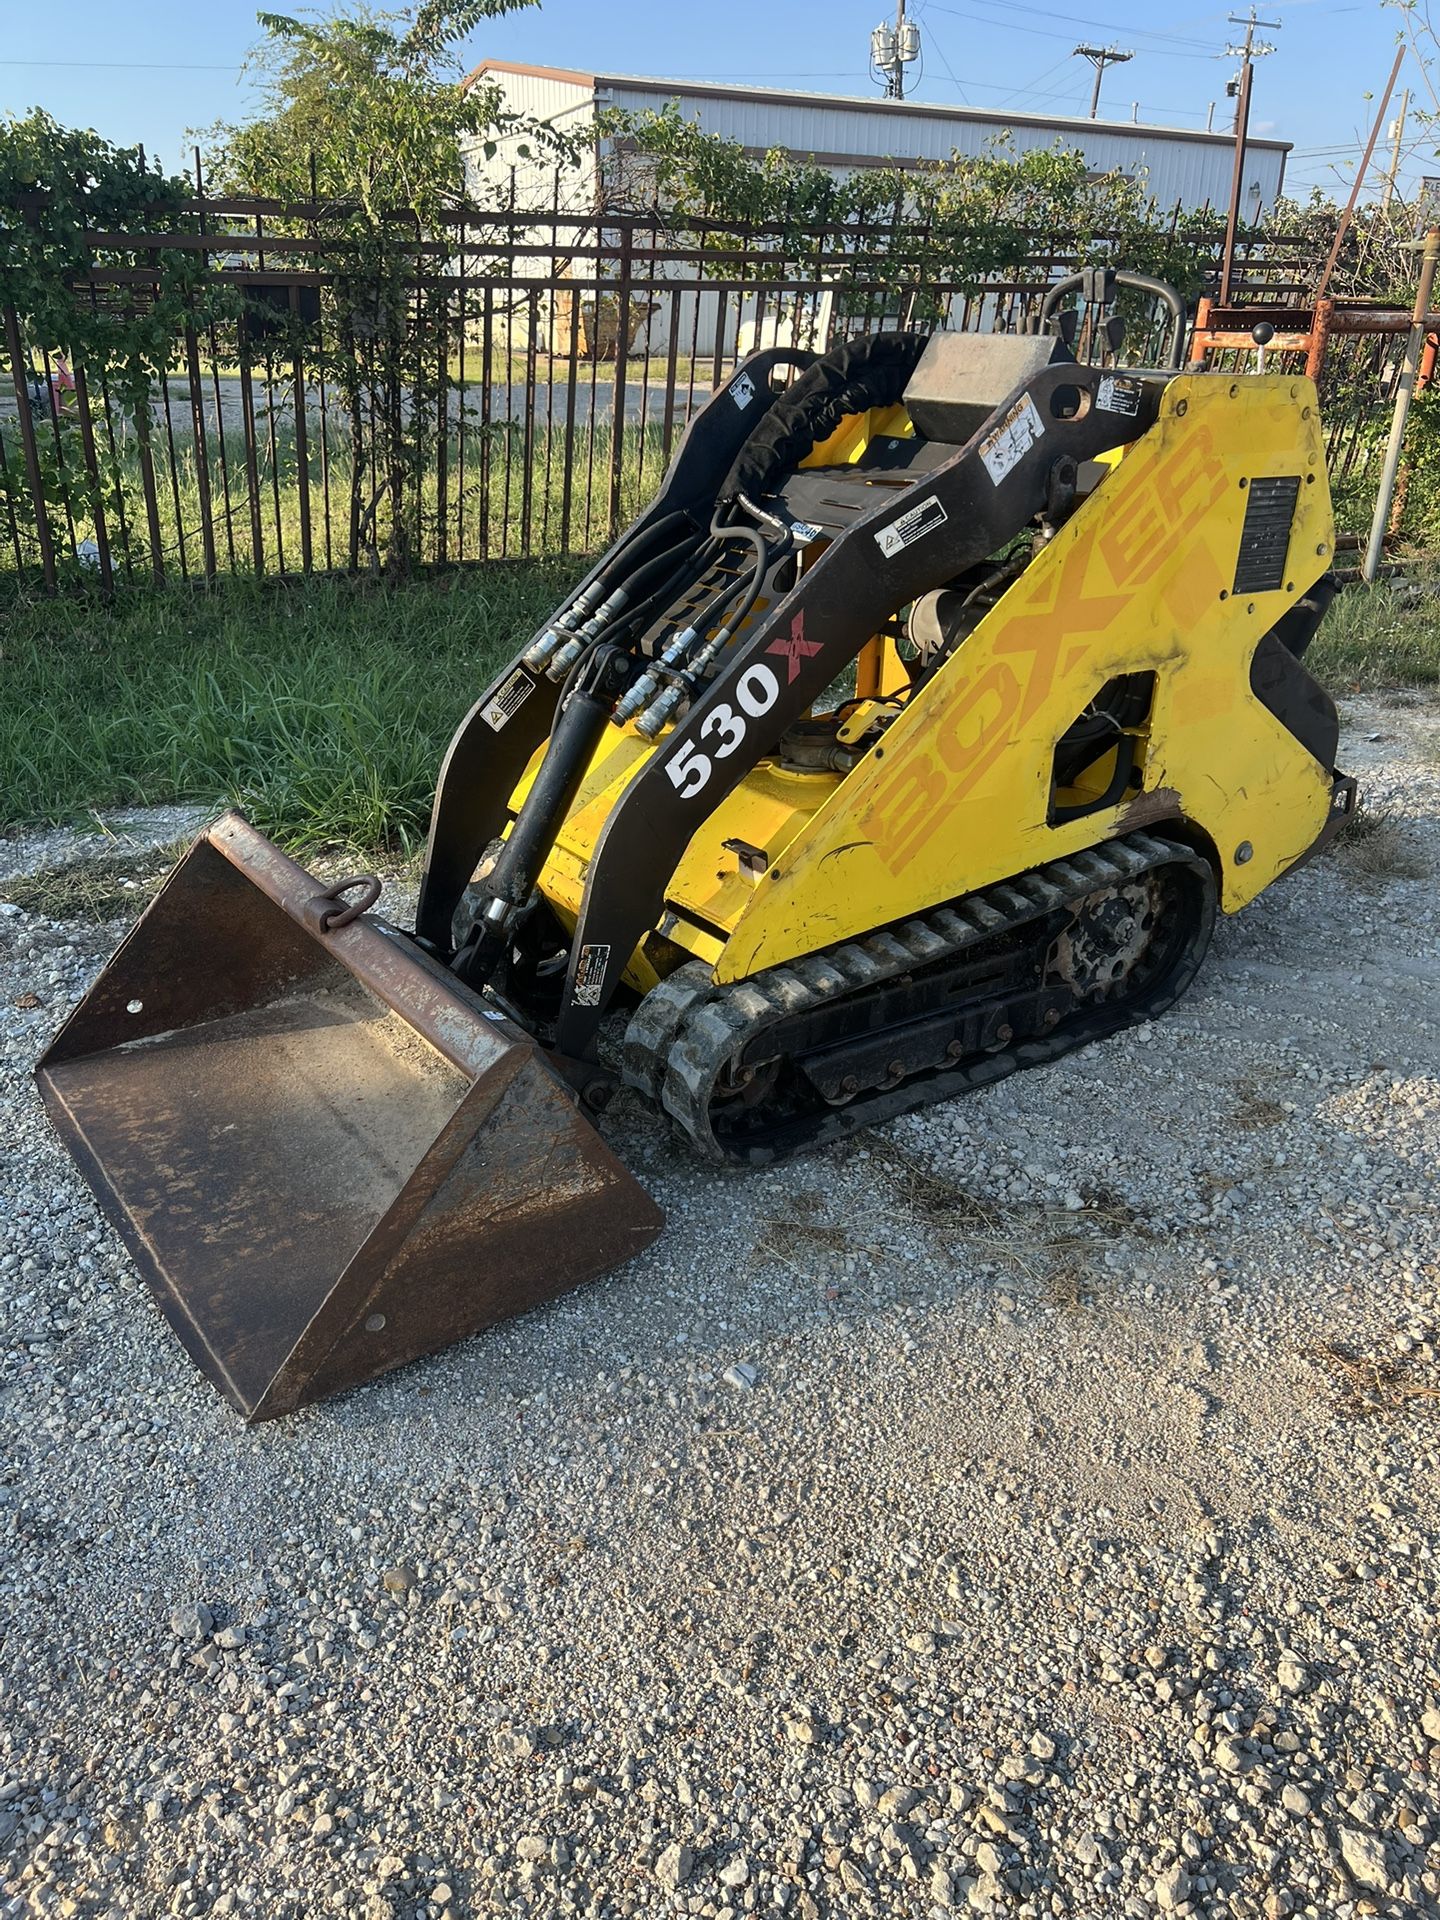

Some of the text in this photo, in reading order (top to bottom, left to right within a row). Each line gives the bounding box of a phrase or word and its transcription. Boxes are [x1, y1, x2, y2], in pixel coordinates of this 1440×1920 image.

[904, 500, 932, 520] CAUTION
[858, 424, 1230, 877] BOXER
[500, 673, 519, 696] CAUTION
